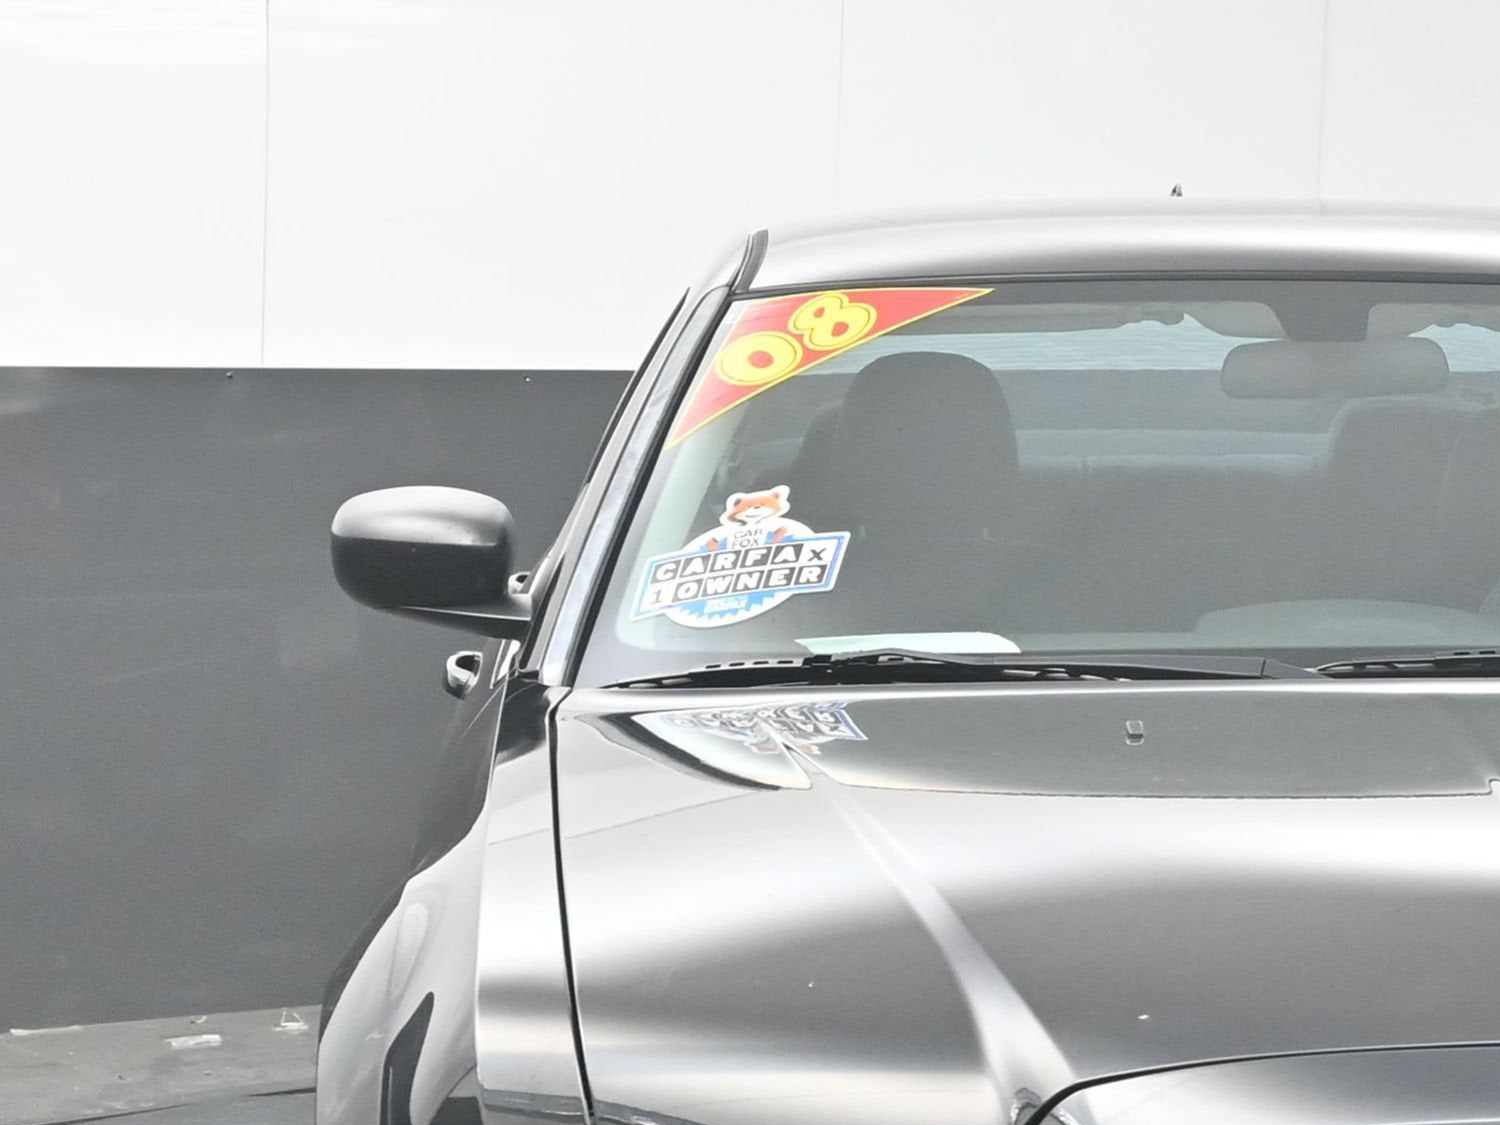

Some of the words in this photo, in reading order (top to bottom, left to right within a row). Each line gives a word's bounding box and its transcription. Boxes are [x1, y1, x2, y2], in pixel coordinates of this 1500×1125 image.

[715, 291, 877, 386] 08
[655, 546, 827, 582] CARFAX
[676, 567, 823, 599] OWNER
